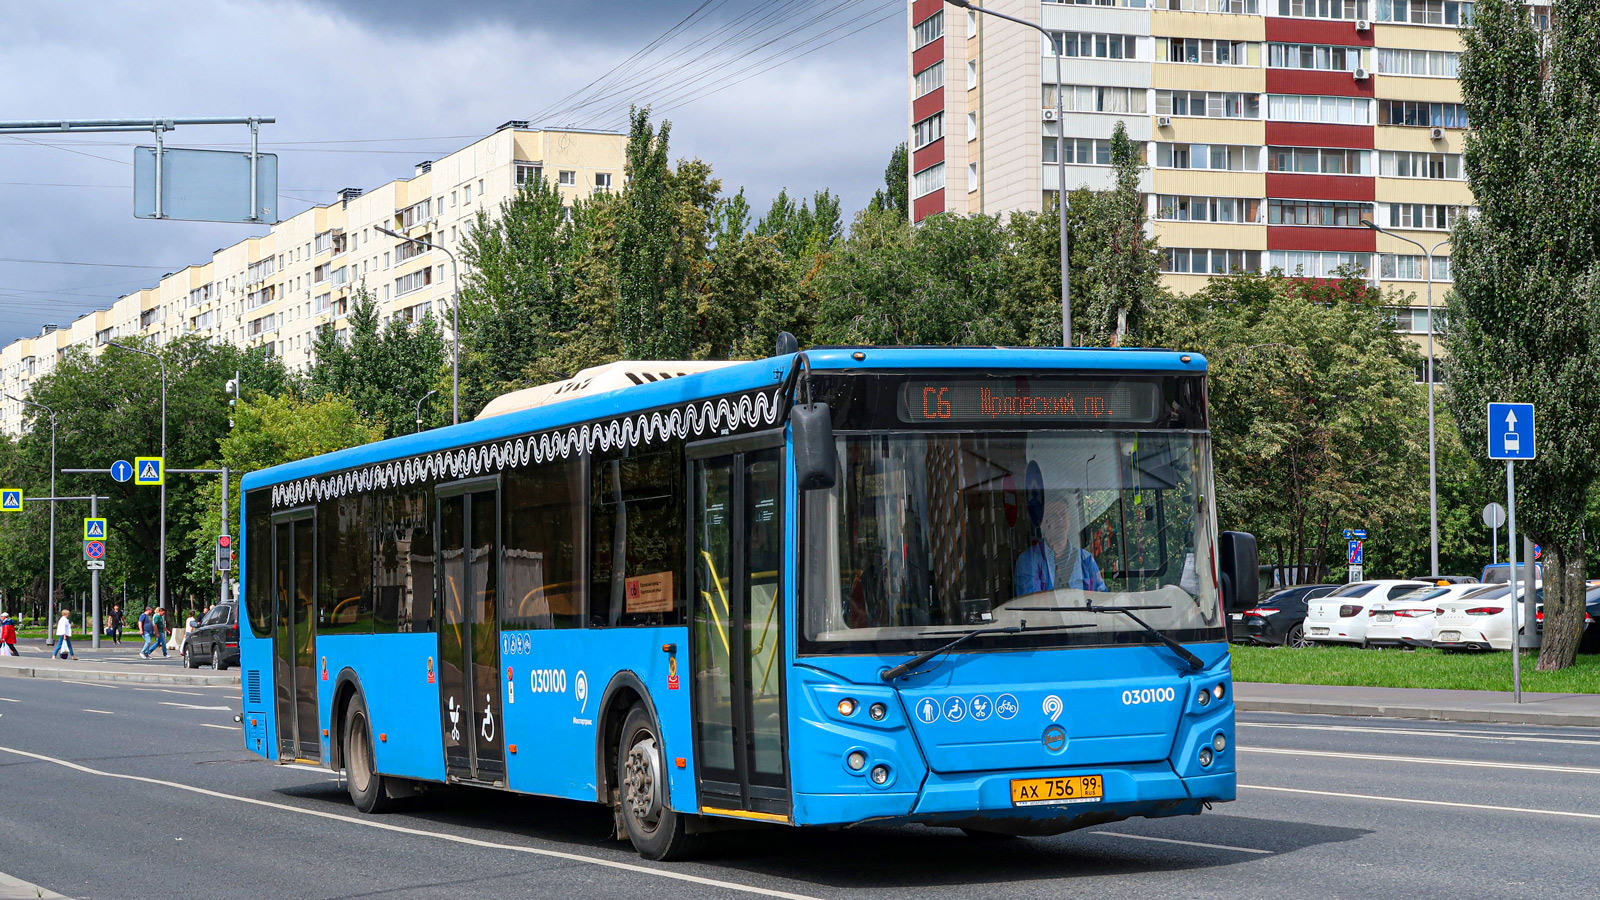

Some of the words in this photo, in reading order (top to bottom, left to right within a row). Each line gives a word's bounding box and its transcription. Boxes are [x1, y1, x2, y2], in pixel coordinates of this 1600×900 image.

[1084, 396, 1113, 418] пр.
[531, 668, 567, 693] 030100
[1121, 687, 1175, 705] 030100
[1045, 780, 1074, 797] 756
[1082, 777, 1097, 790] 99
